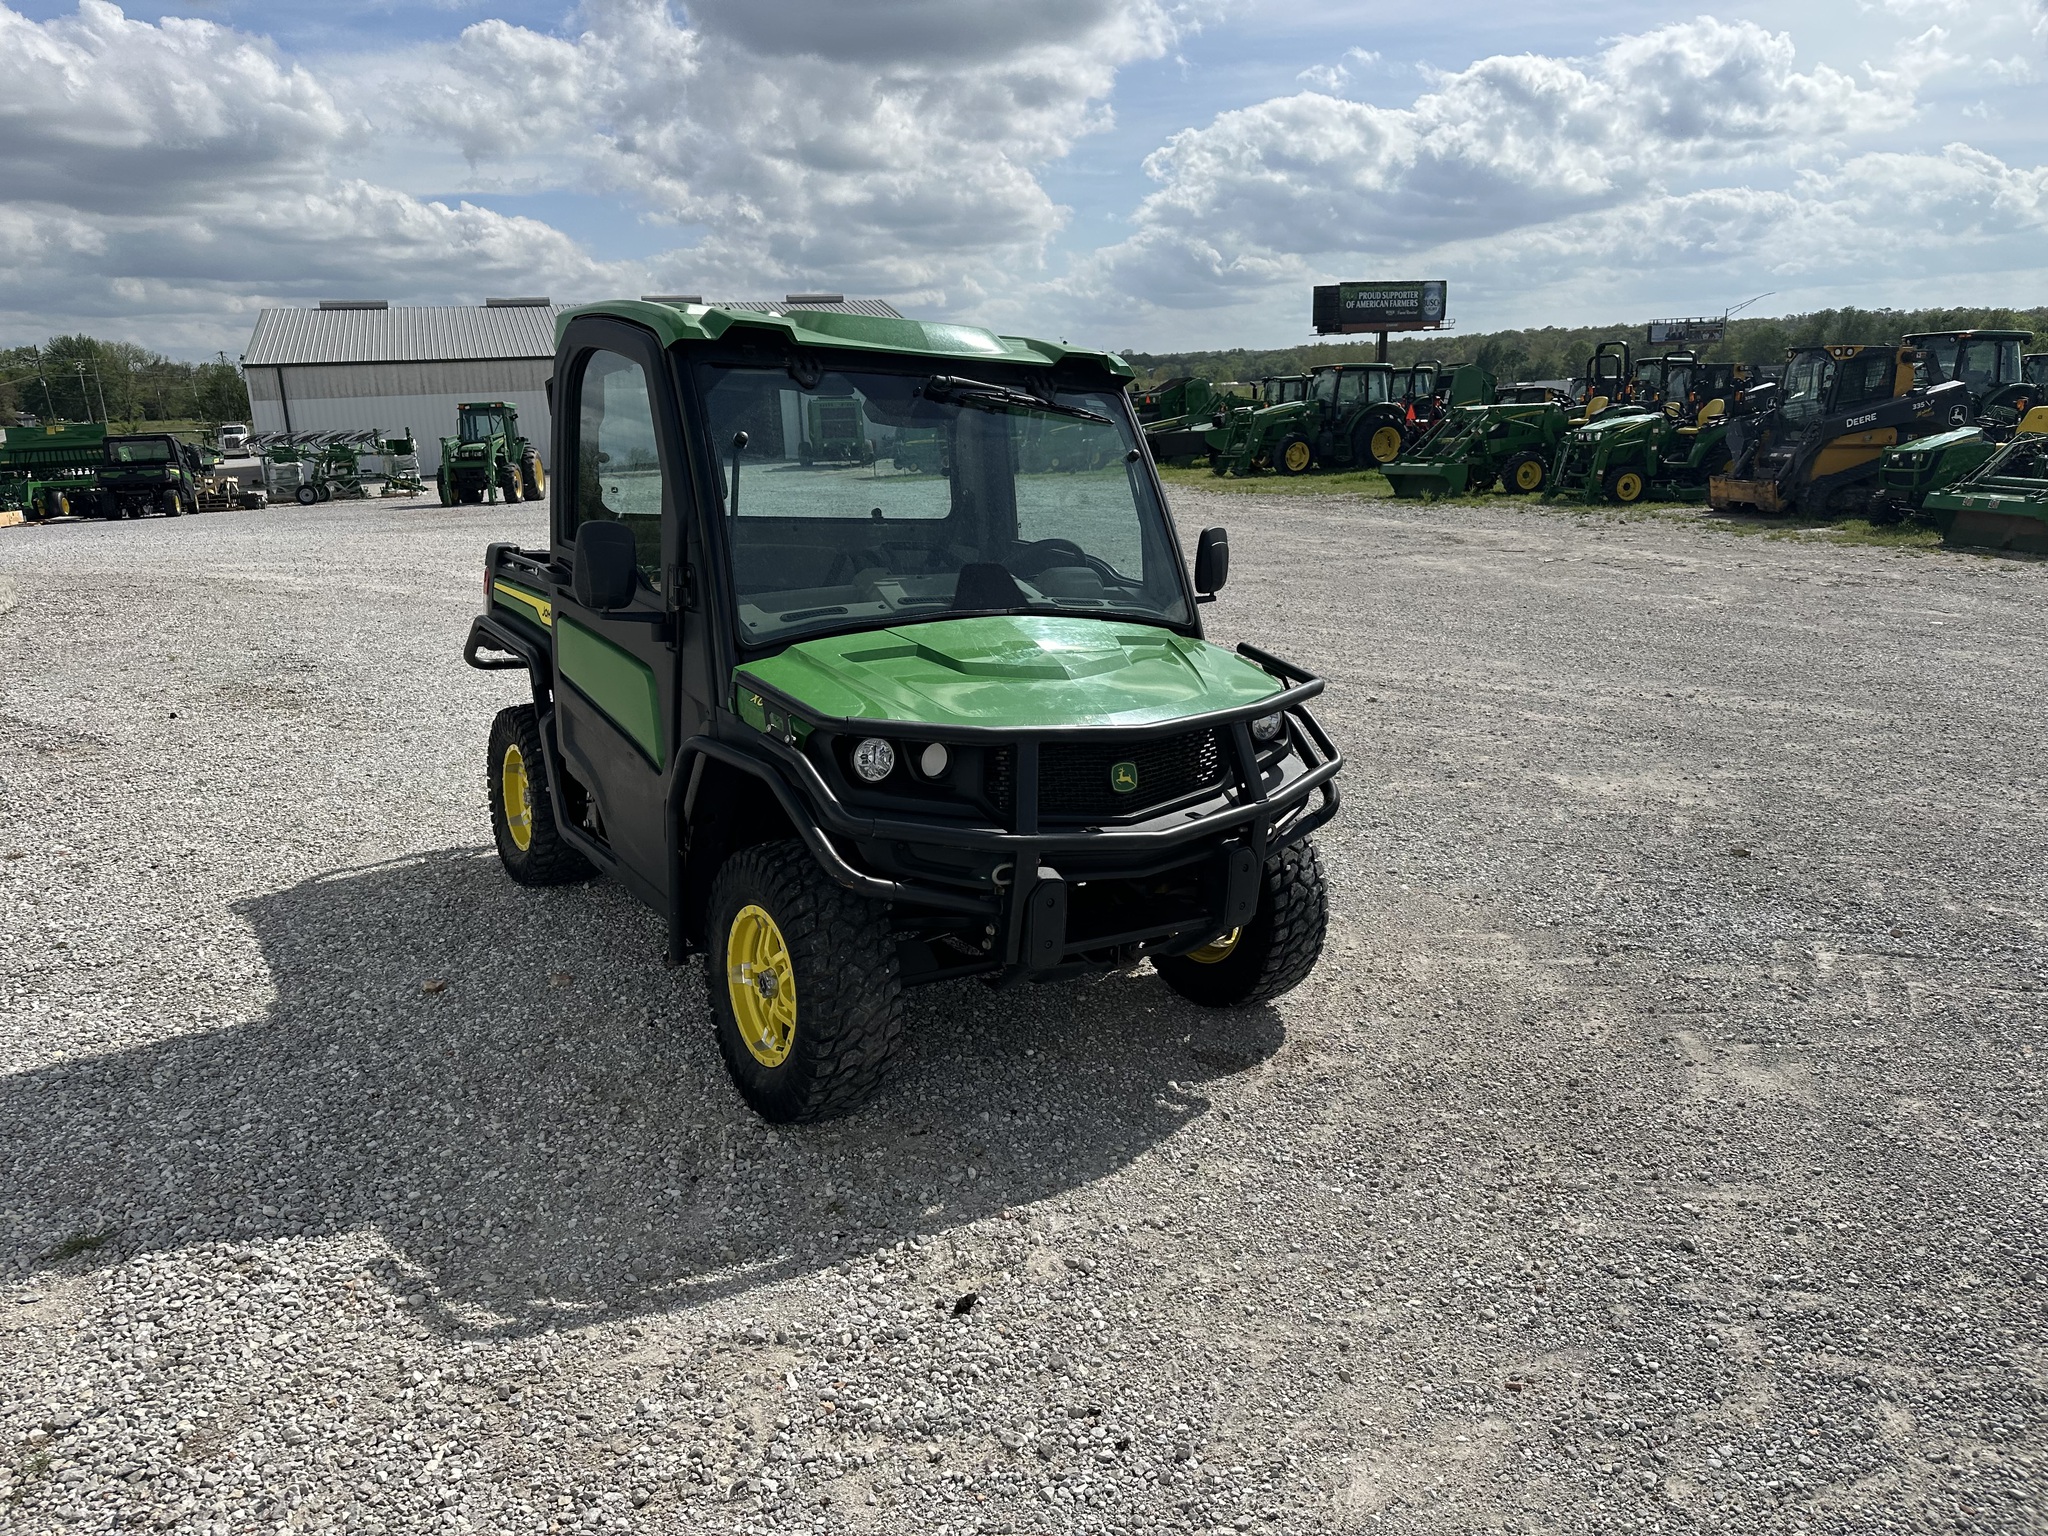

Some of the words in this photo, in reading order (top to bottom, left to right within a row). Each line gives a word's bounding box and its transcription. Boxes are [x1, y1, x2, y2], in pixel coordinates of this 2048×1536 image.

[1359, 291, 1381, 299] PROUD
[1382, 291, 1419, 299] SUPPORTER
[1346, 300, 1355, 308] OF
[1356, 300, 1389, 308] AMERICAN
[1389, 299, 1419, 307] FARMERS
[1846, 412, 1878, 428] DEERE
